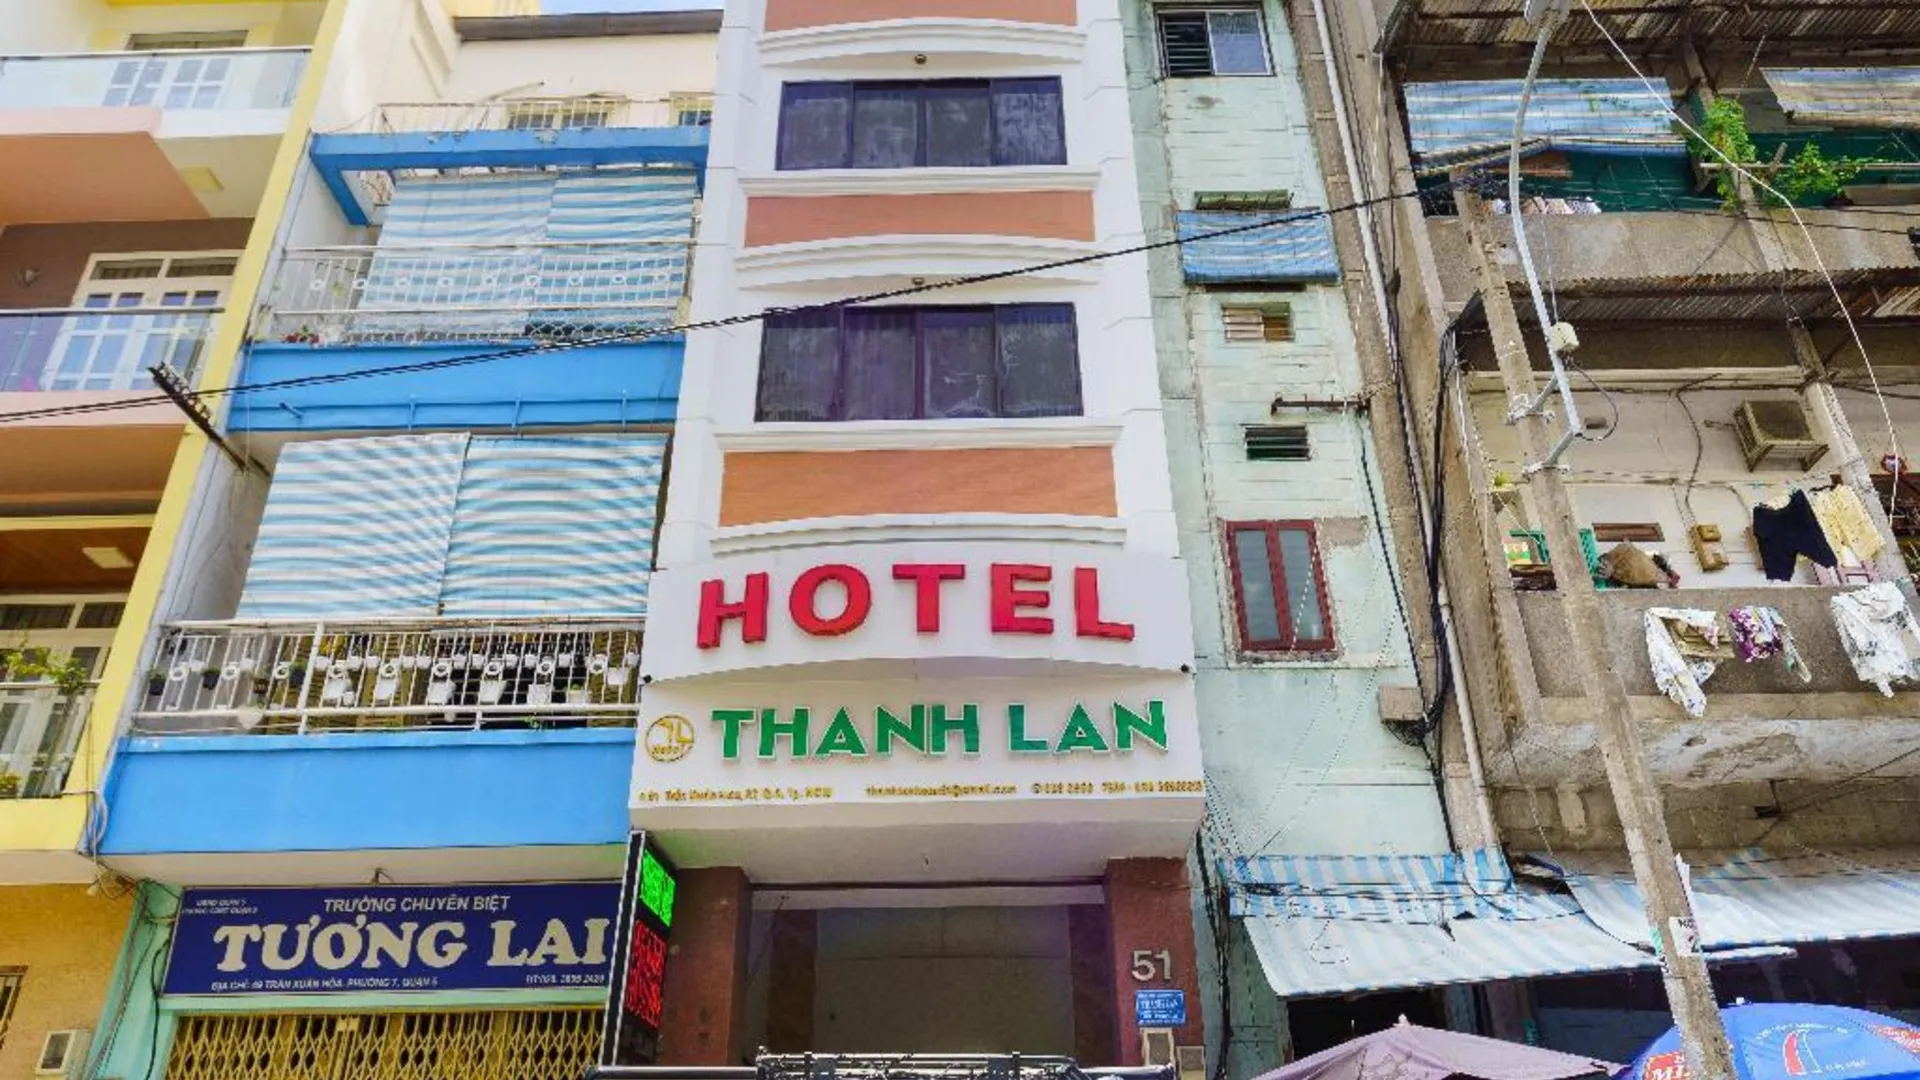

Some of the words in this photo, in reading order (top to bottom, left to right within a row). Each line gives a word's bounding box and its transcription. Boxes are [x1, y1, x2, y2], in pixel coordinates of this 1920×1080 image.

[696, 562, 1135, 649] HOTEL
[710, 702, 981, 761] THANH
[1005, 699, 1170, 755] LAN
[324, 895, 397, 913] TRƯỜNG
[400, 893, 469, 912] CHUYÊN
[472, 894, 511, 914] BIỆT
[213, 914, 468, 972] TƯƠNG
[487, 917, 610, 967] LAI
[1131, 949, 1172, 981] 51
